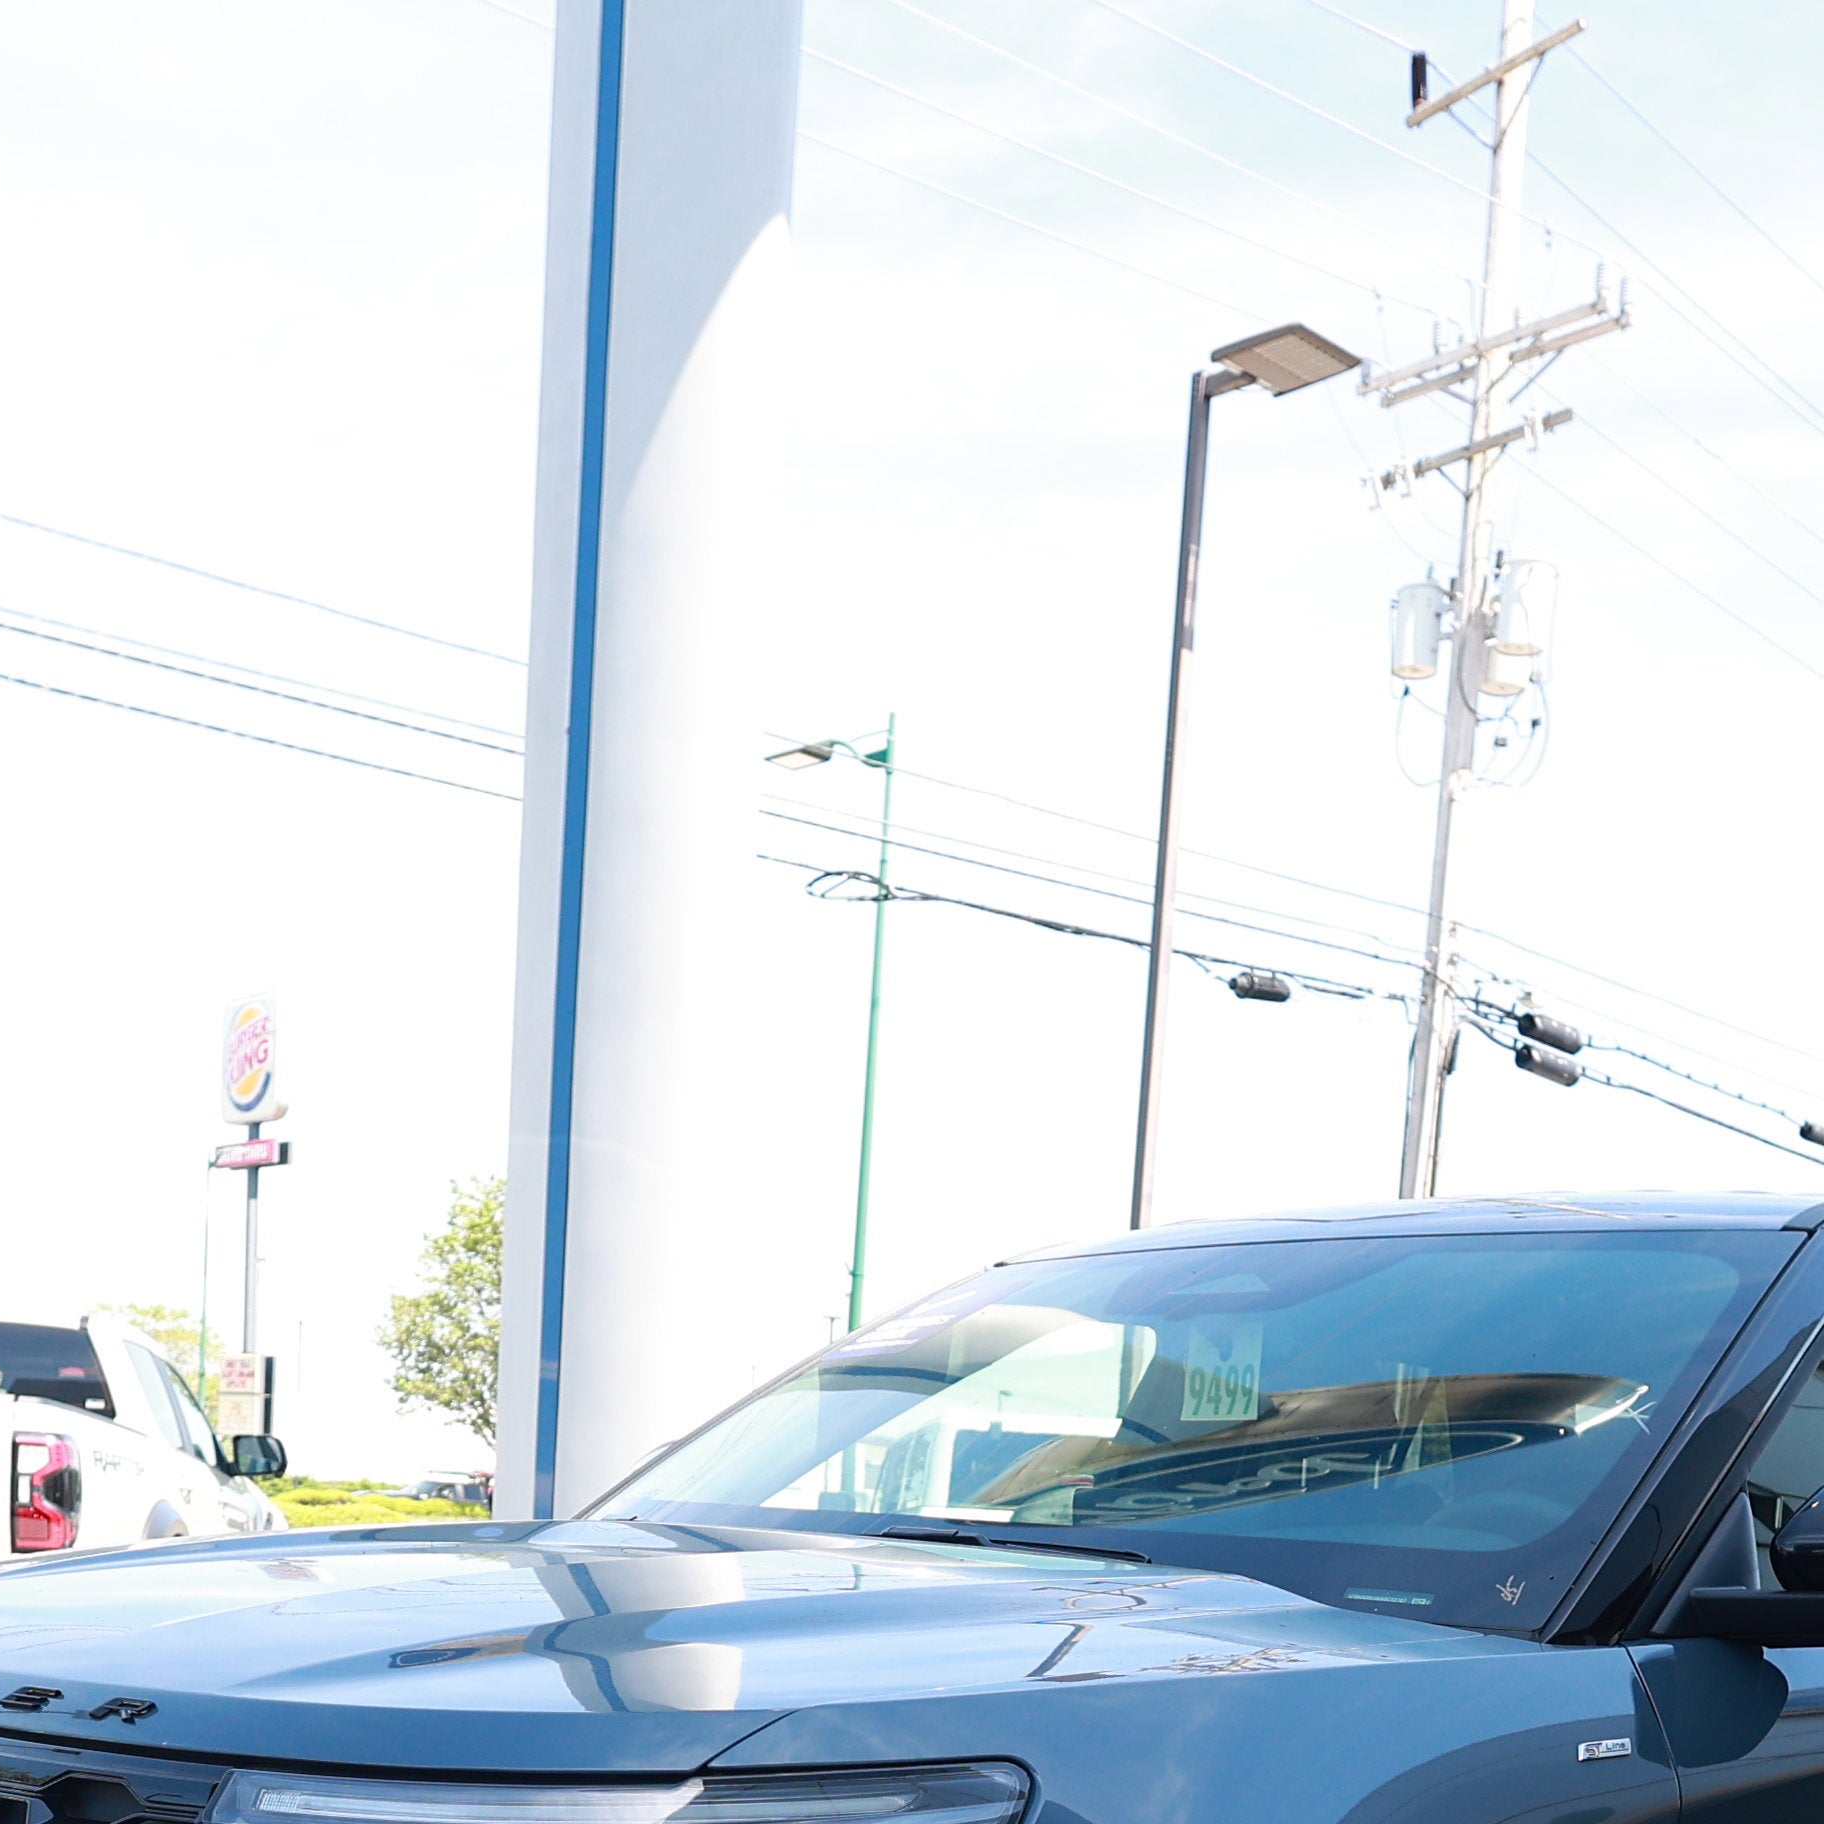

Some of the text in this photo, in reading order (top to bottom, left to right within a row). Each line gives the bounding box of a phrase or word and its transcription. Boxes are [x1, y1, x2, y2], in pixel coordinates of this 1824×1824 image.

[1188, 1363, 1256, 1416] 9499
[1585, 1741, 1627, 1759] ST Line
